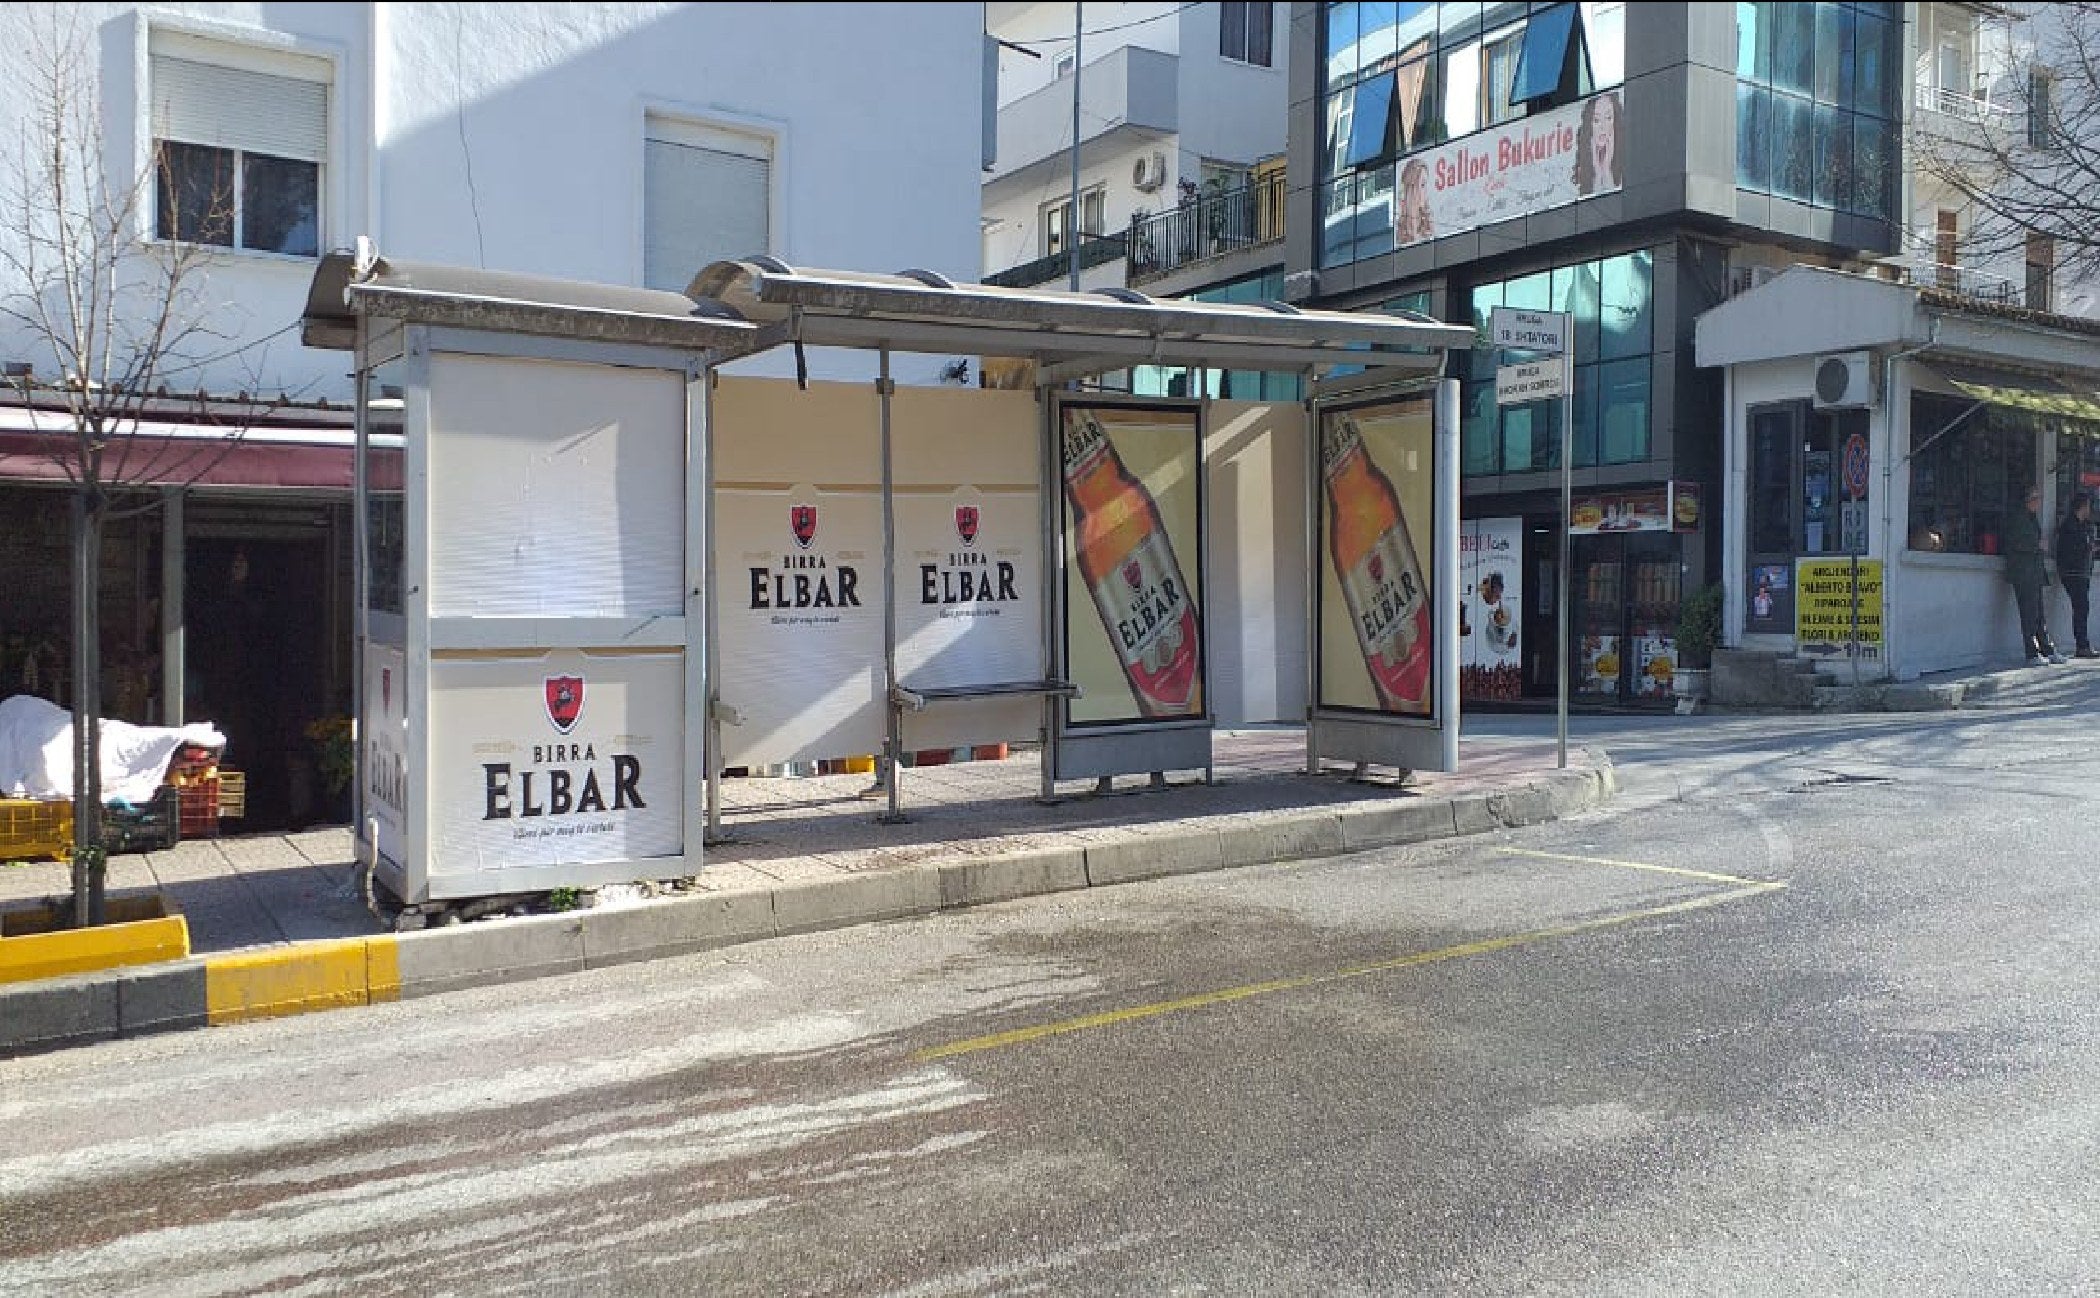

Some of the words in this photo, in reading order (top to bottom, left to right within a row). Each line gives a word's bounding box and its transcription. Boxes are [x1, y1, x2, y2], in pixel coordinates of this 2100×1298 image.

[1434, 149, 1490, 191] Sallon
[1498, 121, 1574, 172] Bukurie
[749, 566, 862, 609] ELBAR
[784, 554, 826, 569] BIRRA
[919, 561, 1018, 604] ELBAR
[1118, 577, 1179, 652] ELBAR
[1361, 571, 1417, 641] ELBAR
[533, 743, 598, 763] BIRRA
[482, 754, 647, 821] ELBAR
